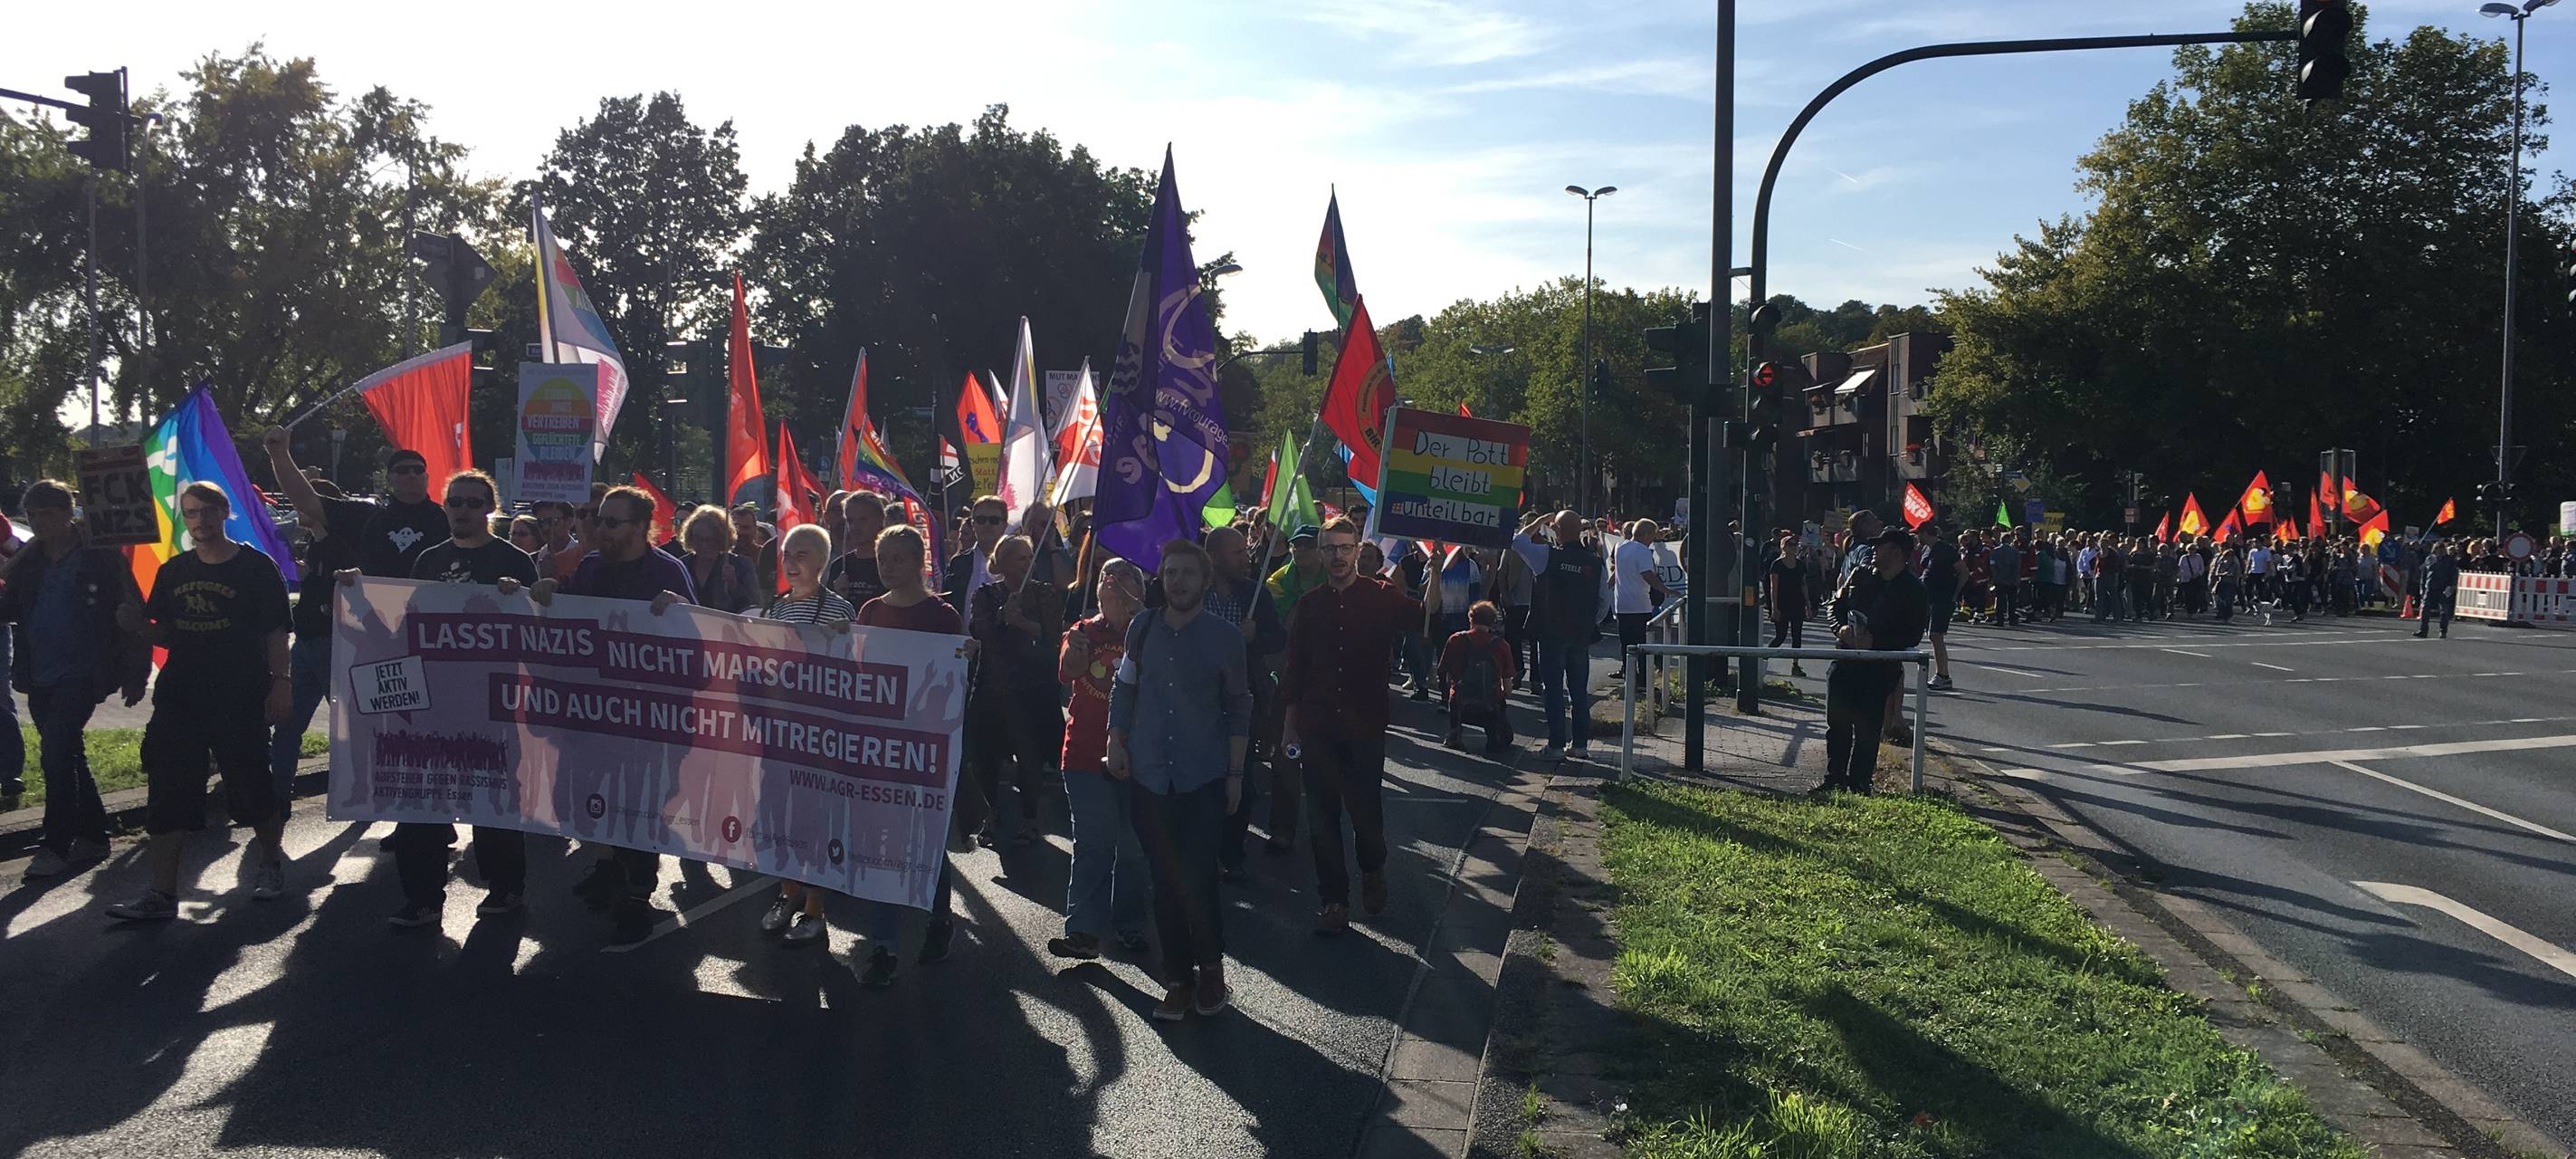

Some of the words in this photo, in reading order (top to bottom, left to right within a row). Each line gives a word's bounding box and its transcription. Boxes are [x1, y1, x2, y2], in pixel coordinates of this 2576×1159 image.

[1050, 372, 1065, 380] MUT
[526, 416, 580, 429] VERTREIBEN
[1413, 429, 1451, 457] Der
[1466, 438, 1508, 465] Pott
[83, 471, 150, 506] FCK
[1429, 465, 1491, 494] bleibt
[90, 508, 155, 536] NZS
[1559, 562, 1582, 573] STEELE
[173, 580, 236, 599] REFUGEES
[375, 662, 404, 680] JETZT
[418, 622, 512, 650] LASST
[519, 624, 595, 656] NAZIS
[607, 640, 694, 675] NICHT
[702, 650, 898, 705] MARSCHIEREN
[377, 677, 407, 695] AKTIV
[370, 691, 421, 711] WERDEN!
[501, 684, 560, 714] UND
[566, 693, 642, 726] AUCH
[650, 702, 735, 739] NICHT
[742, 714, 938, 774] MITREGIEREN!
[374, 771, 424, 784] AUFSTEHEN
[426, 773, 457, 785] GEGEN
[459, 775, 508, 790] RASSISMUS
[790, 769, 945, 811] WWW.AGR-ESSEN.DE
[373, 786, 443, 800] AKTIVENGRUPPE
[447, 788, 473, 801] Essen
